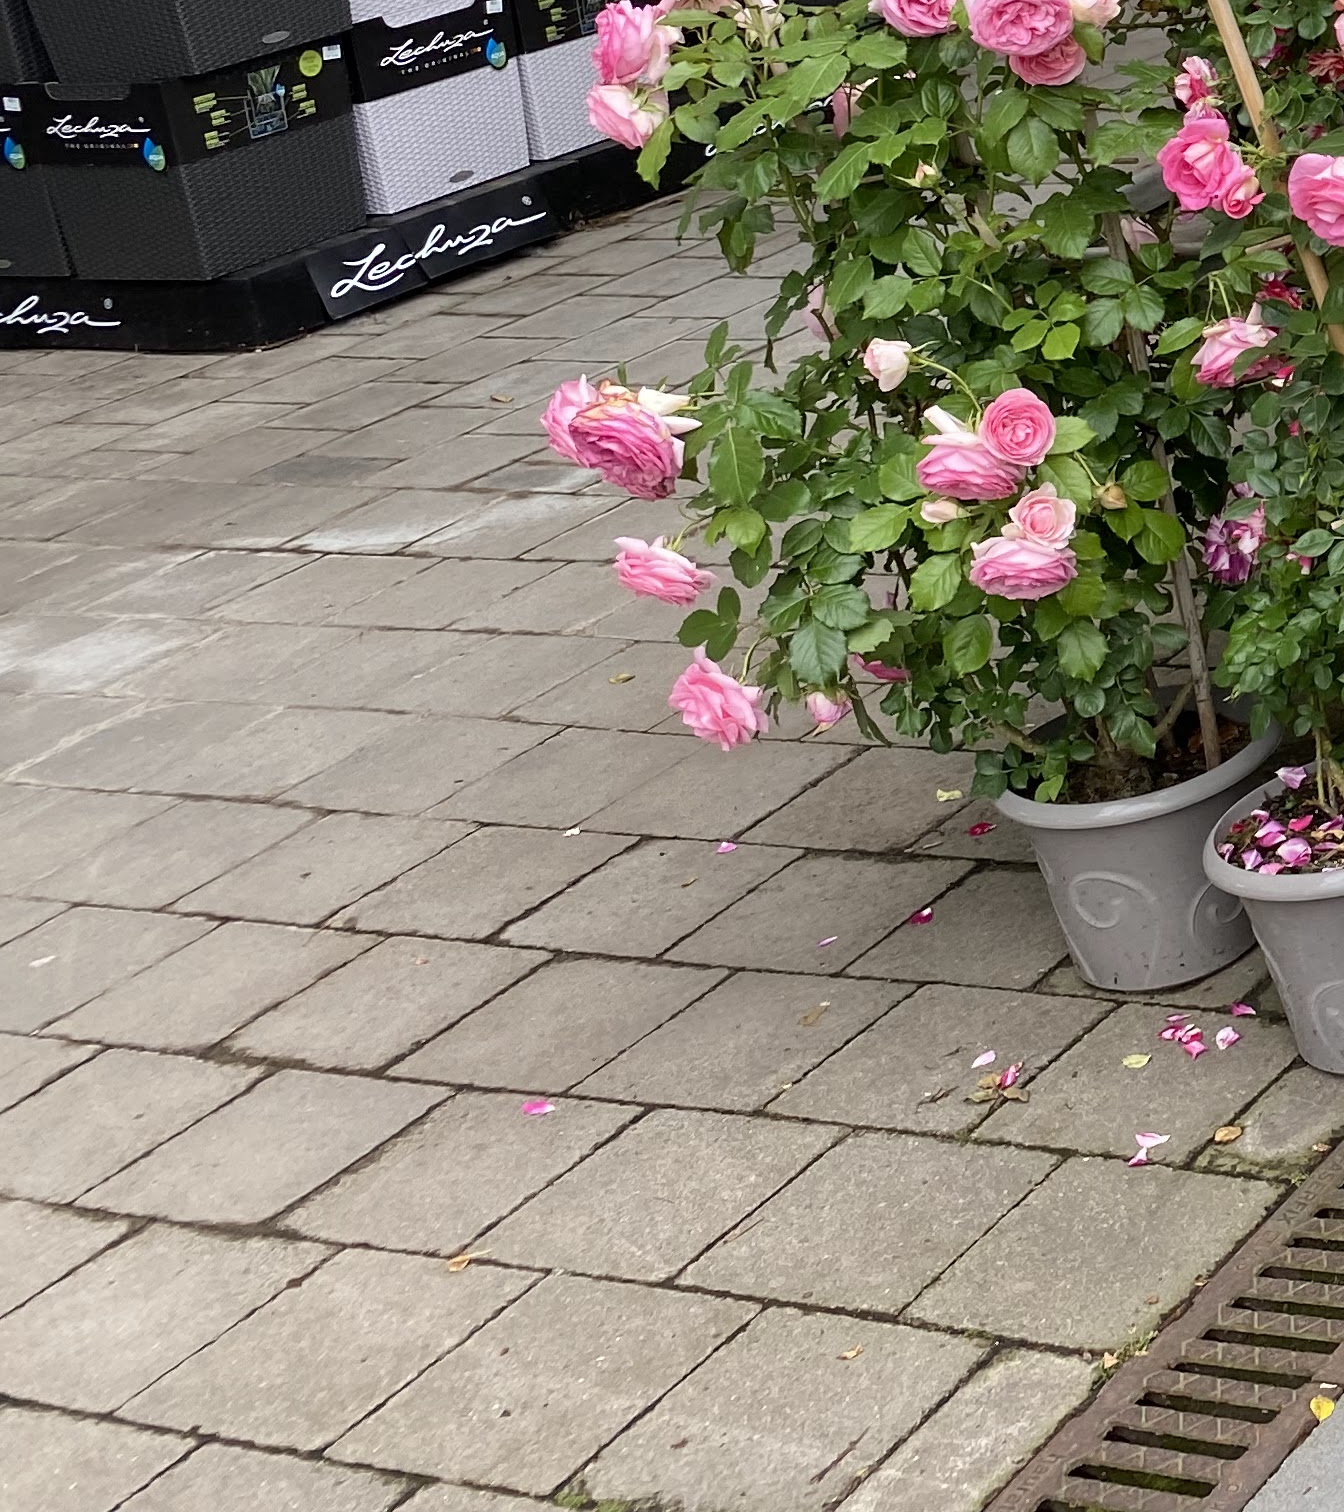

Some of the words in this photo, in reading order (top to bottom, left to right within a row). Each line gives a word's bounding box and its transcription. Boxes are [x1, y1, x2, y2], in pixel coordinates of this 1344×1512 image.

[380, 28, 495, 67] Lechuza
[46, 114, 151, 139] Lechuza
[330, 212, 547, 298] Lechuza
